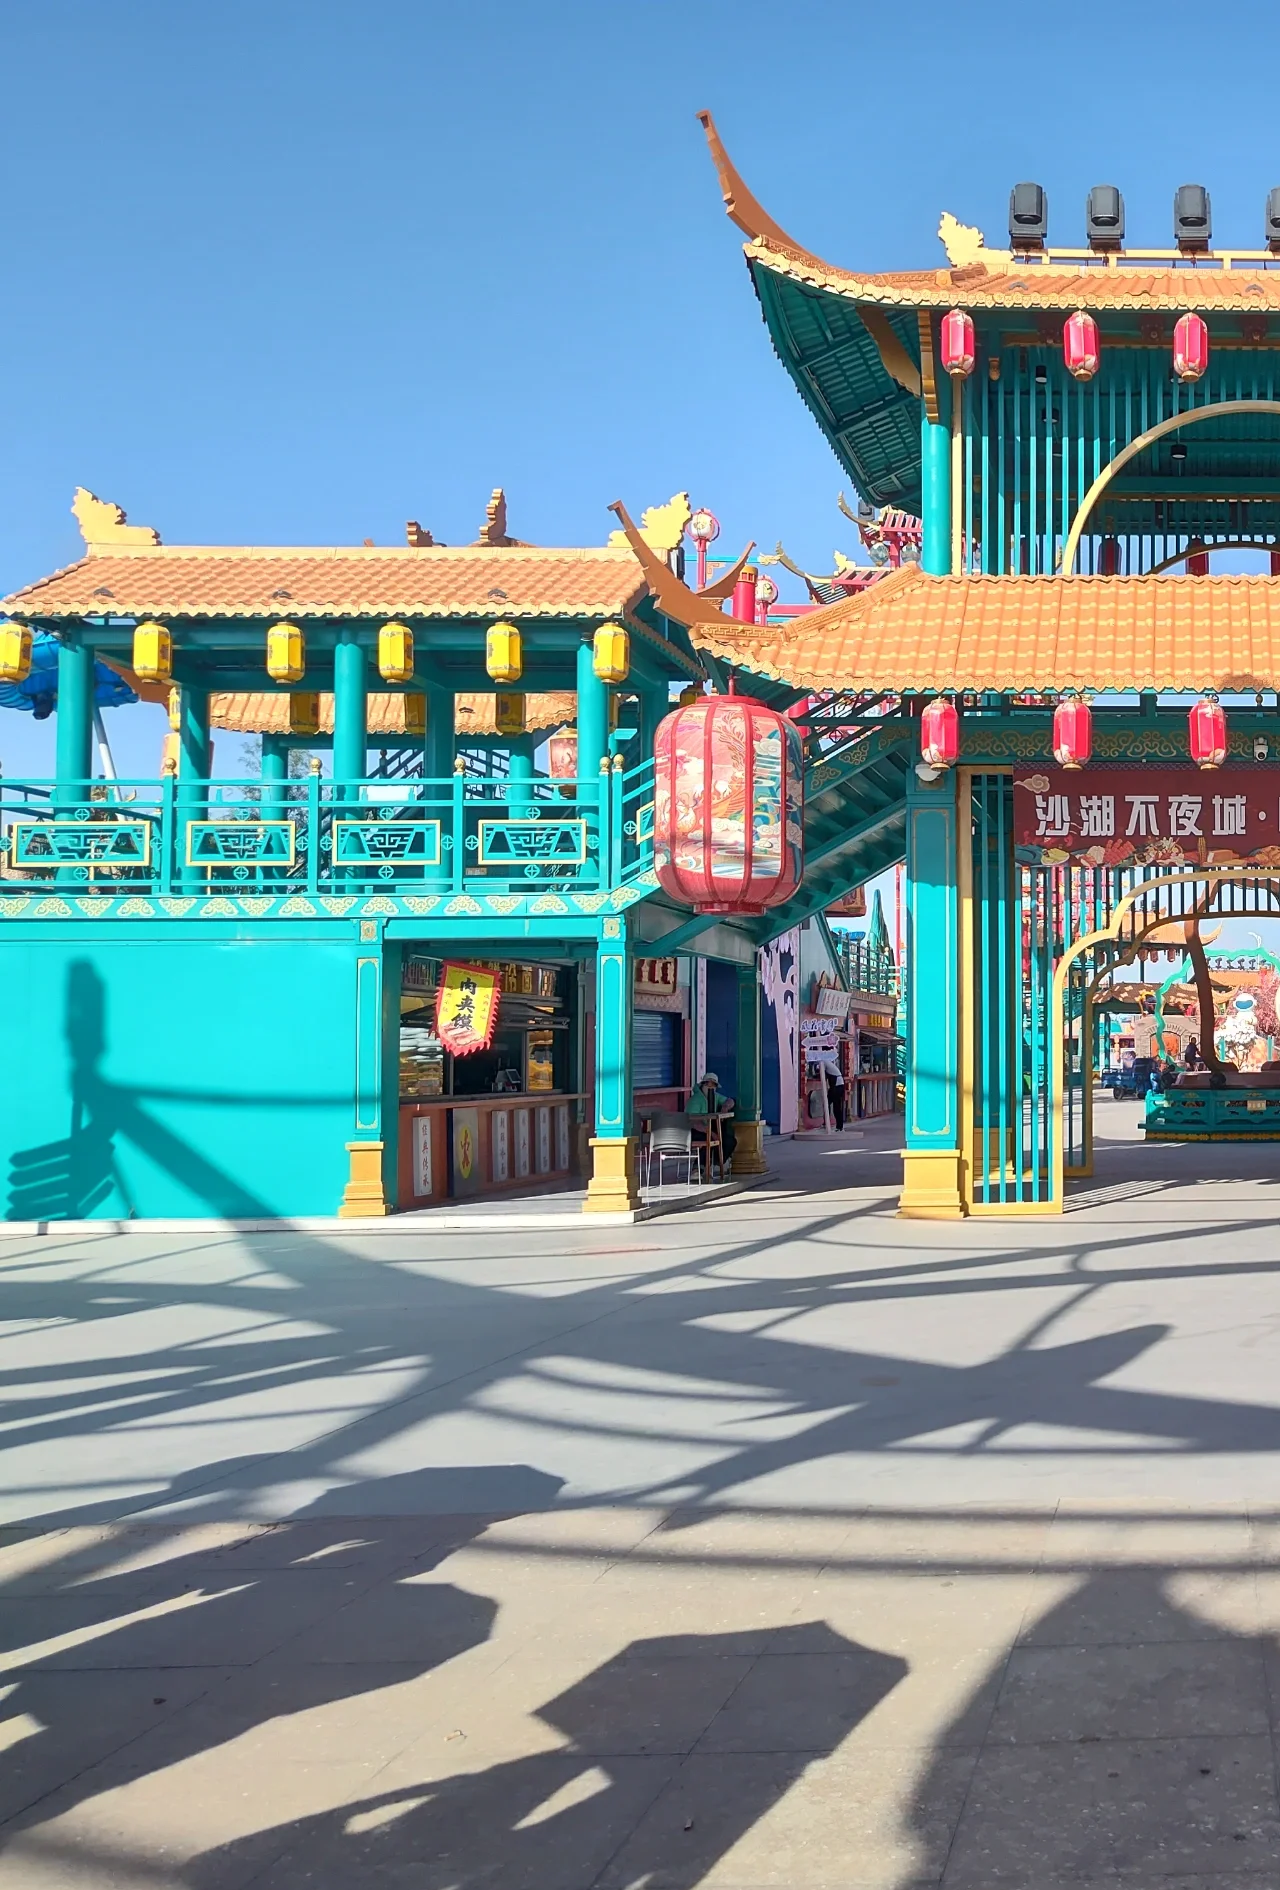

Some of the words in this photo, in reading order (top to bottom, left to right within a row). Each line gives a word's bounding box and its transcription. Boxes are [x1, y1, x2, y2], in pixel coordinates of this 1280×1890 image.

[451, 977, 478, 1030] 肉夹馍
[421, 1124, 430, 1187] 经典传承
